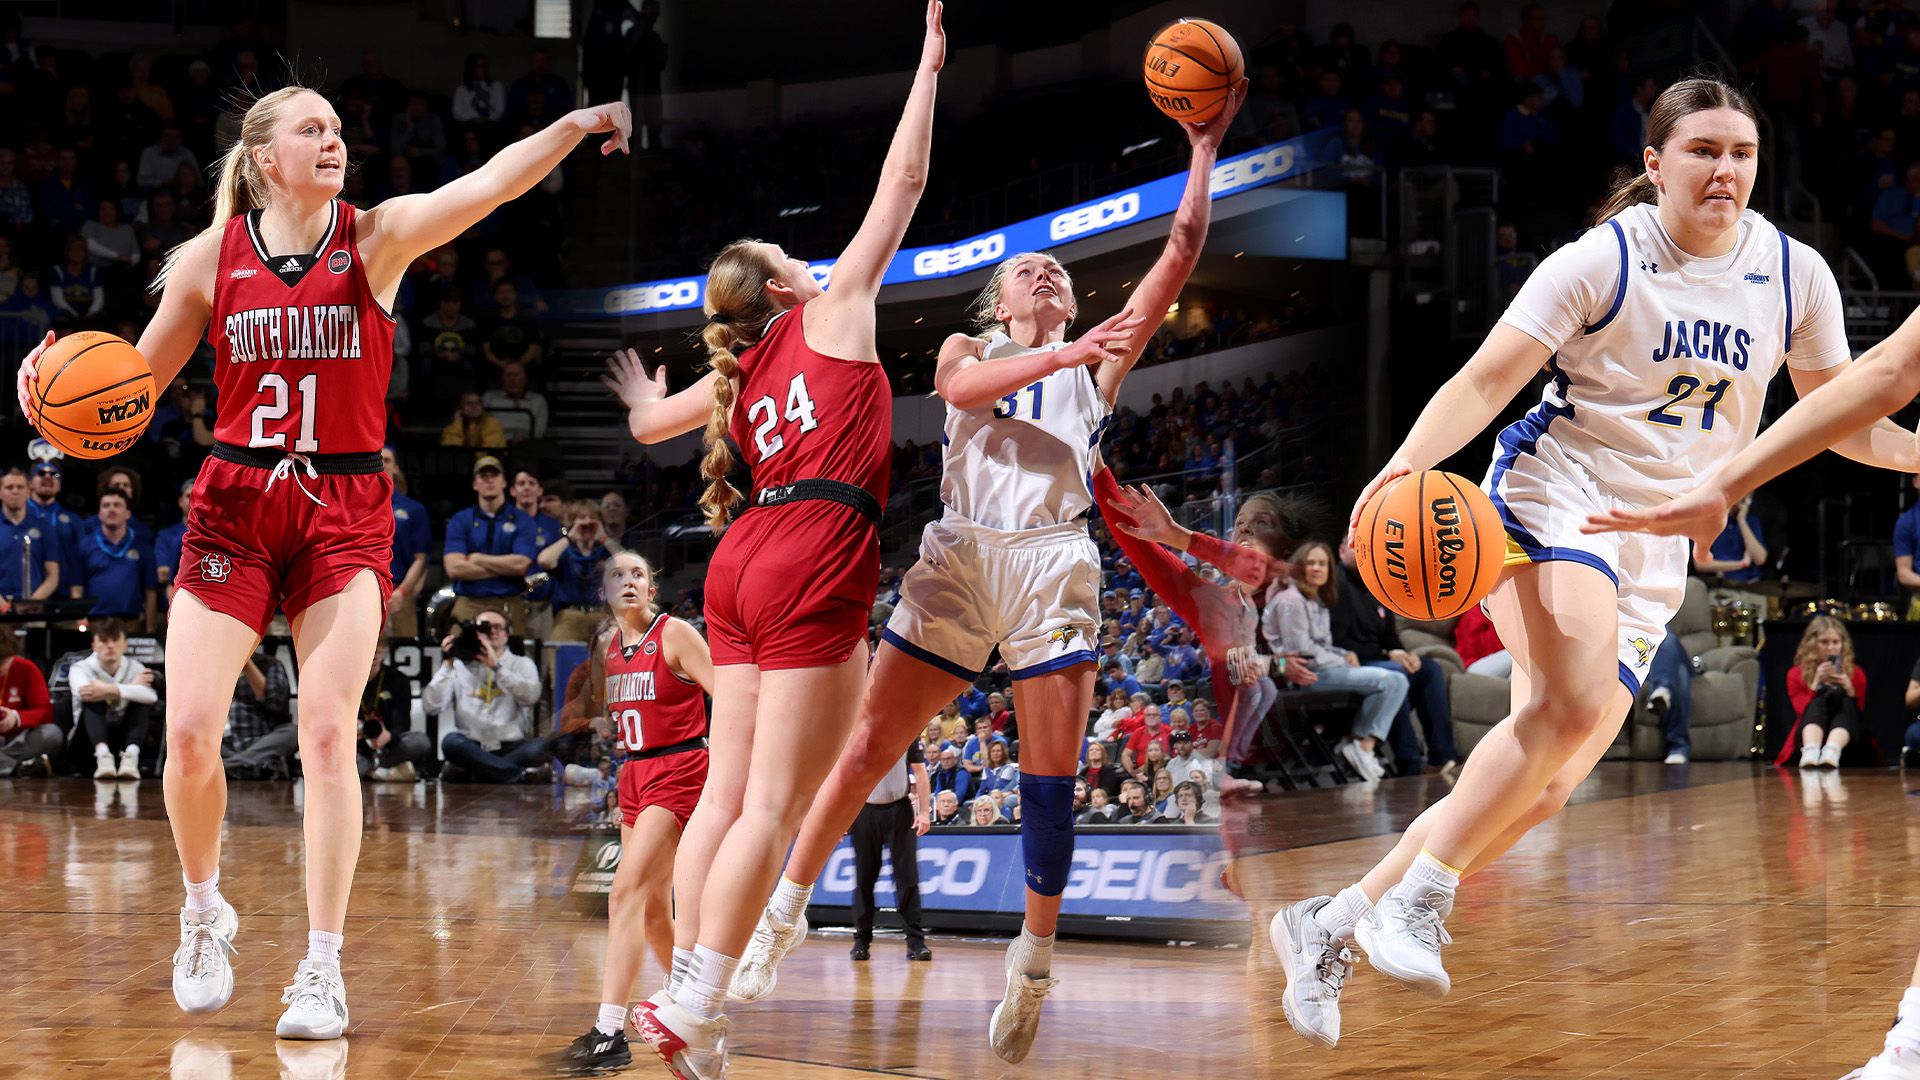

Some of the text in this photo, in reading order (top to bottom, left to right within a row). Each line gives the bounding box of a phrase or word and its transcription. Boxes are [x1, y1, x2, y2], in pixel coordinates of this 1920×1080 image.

[1050, 193, 1140, 241] GEICO
[278, 265, 304, 274] adidas
[913, 233, 1006, 277] GEICO
[1743, 274, 1770, 282] SUMMIT
[604, 280, 699, 314] GEICO
[225, 305, 362, 364] SOUTH DAKOTA
[1652, 319, 1751, 372] JACKS
[97, 390, 150, 425] NCAA
[248, 373, 320, 453] 21
[747, 371, 819, 464] 24
[1645, 371, 1735, 434] 21
[1385, 519, 1409, 581] EVO
[1429, 495, 1465, 599] Wilson
[620, 671, 657, 703] DAKOTA
[822, 847, 991, 896] GCO
